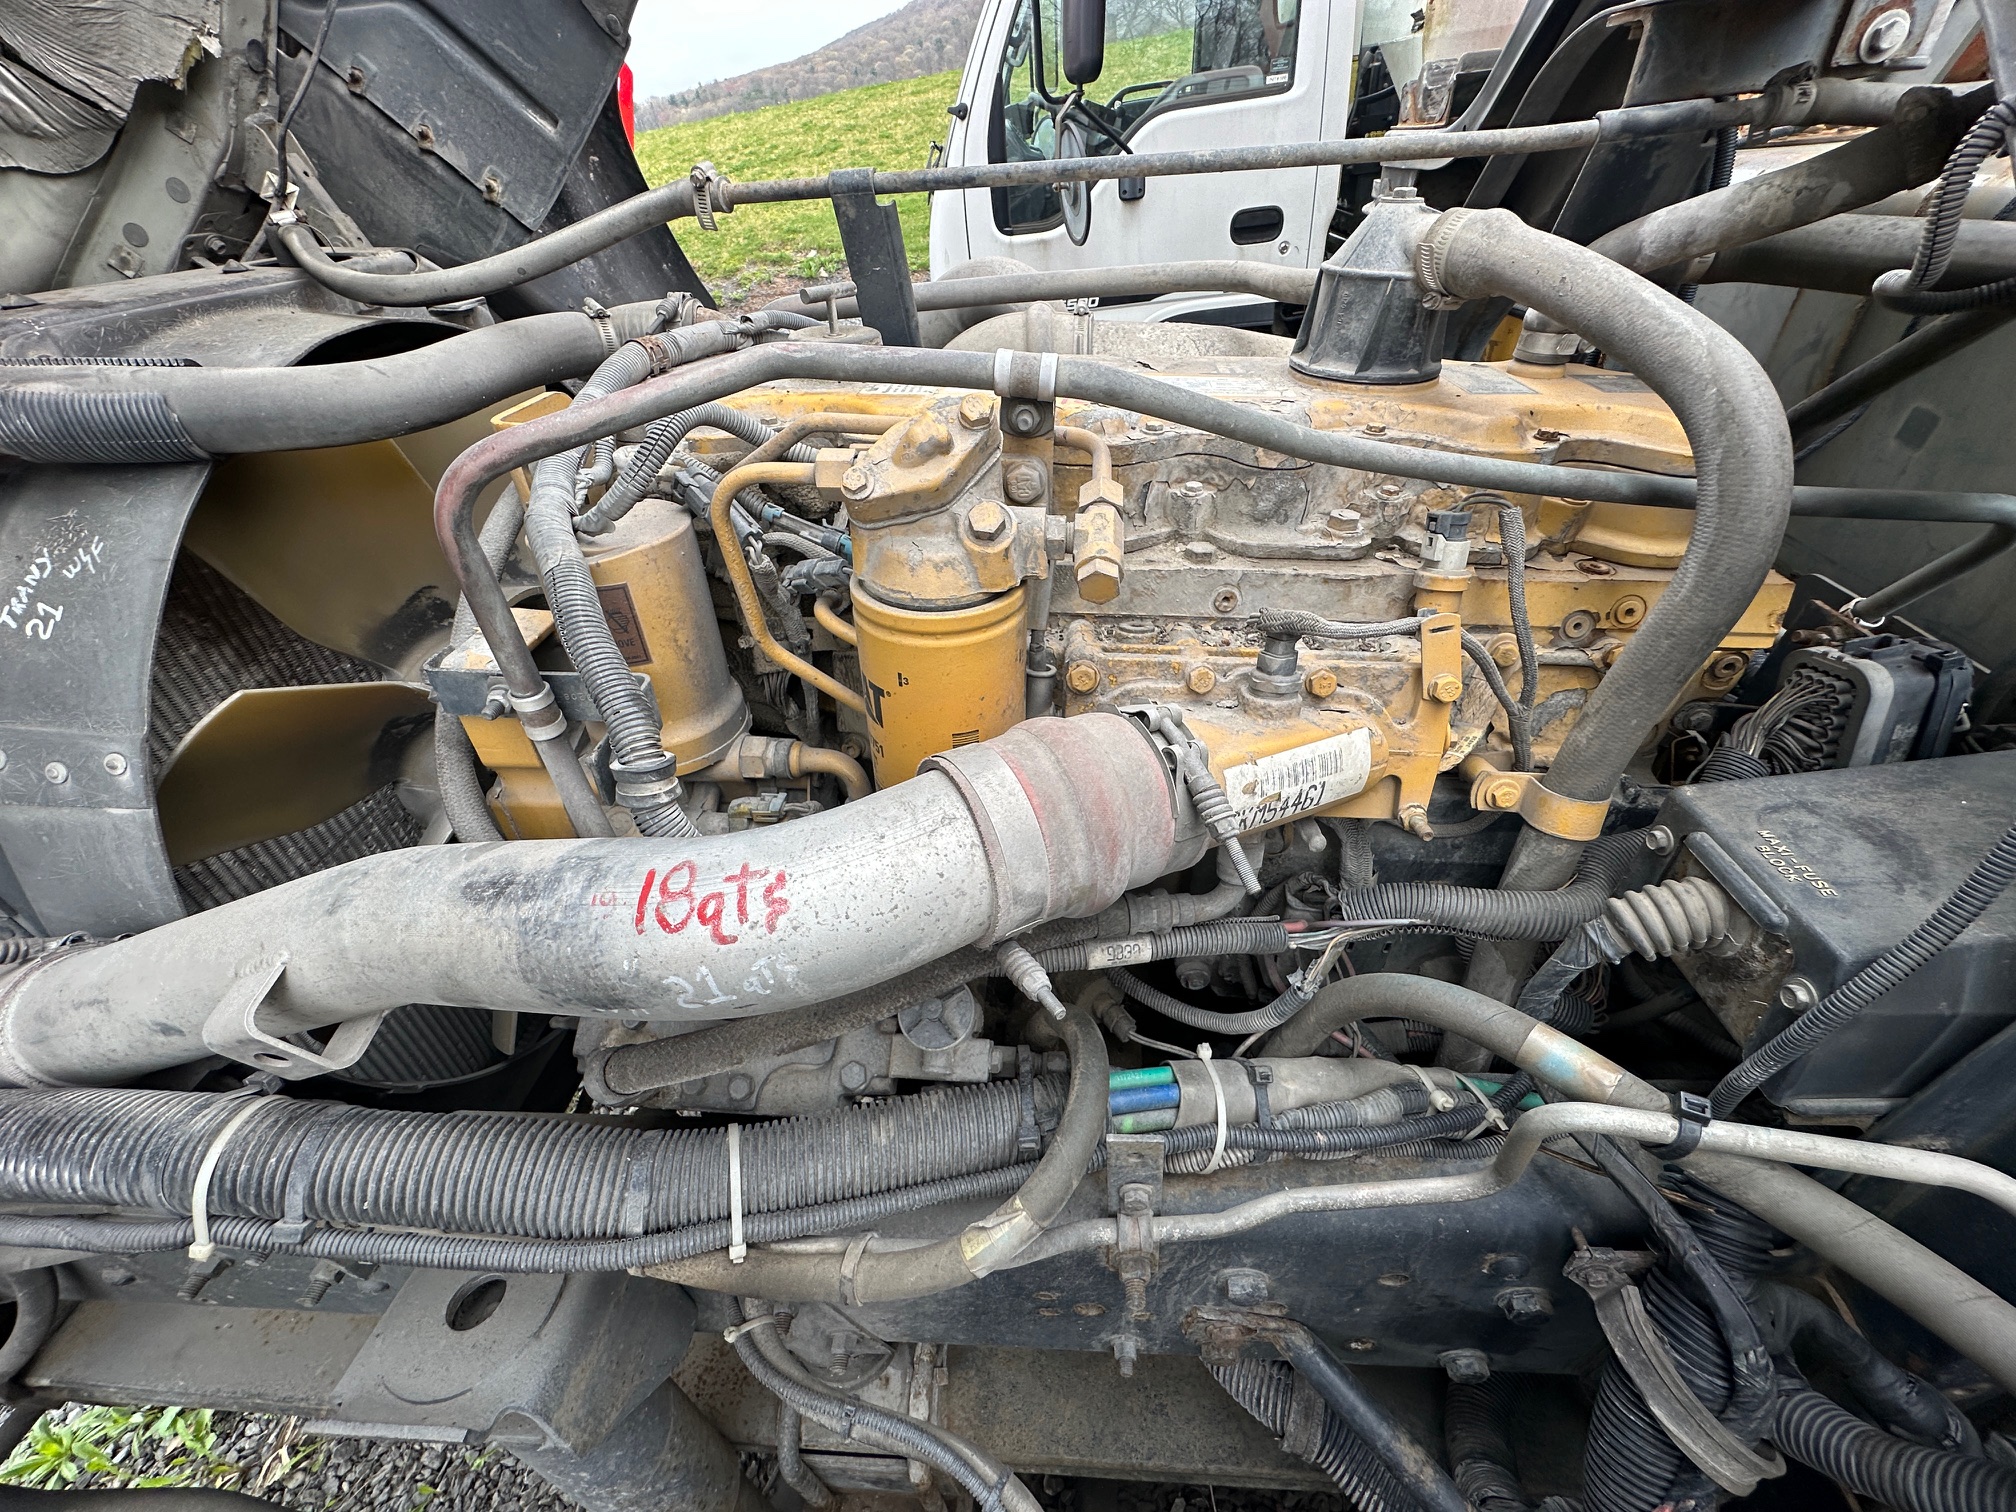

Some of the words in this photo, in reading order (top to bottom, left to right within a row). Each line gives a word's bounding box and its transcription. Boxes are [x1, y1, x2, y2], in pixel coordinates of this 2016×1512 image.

[25, 602, 64, 640] 21
[1234, 781, 1326, 831] KM54461
[1755, 845, 1803, 882] BLOCK
[1756, 830, 1839, 897] MAXI-FUSE
[662, 965, 738, 1009] 21
